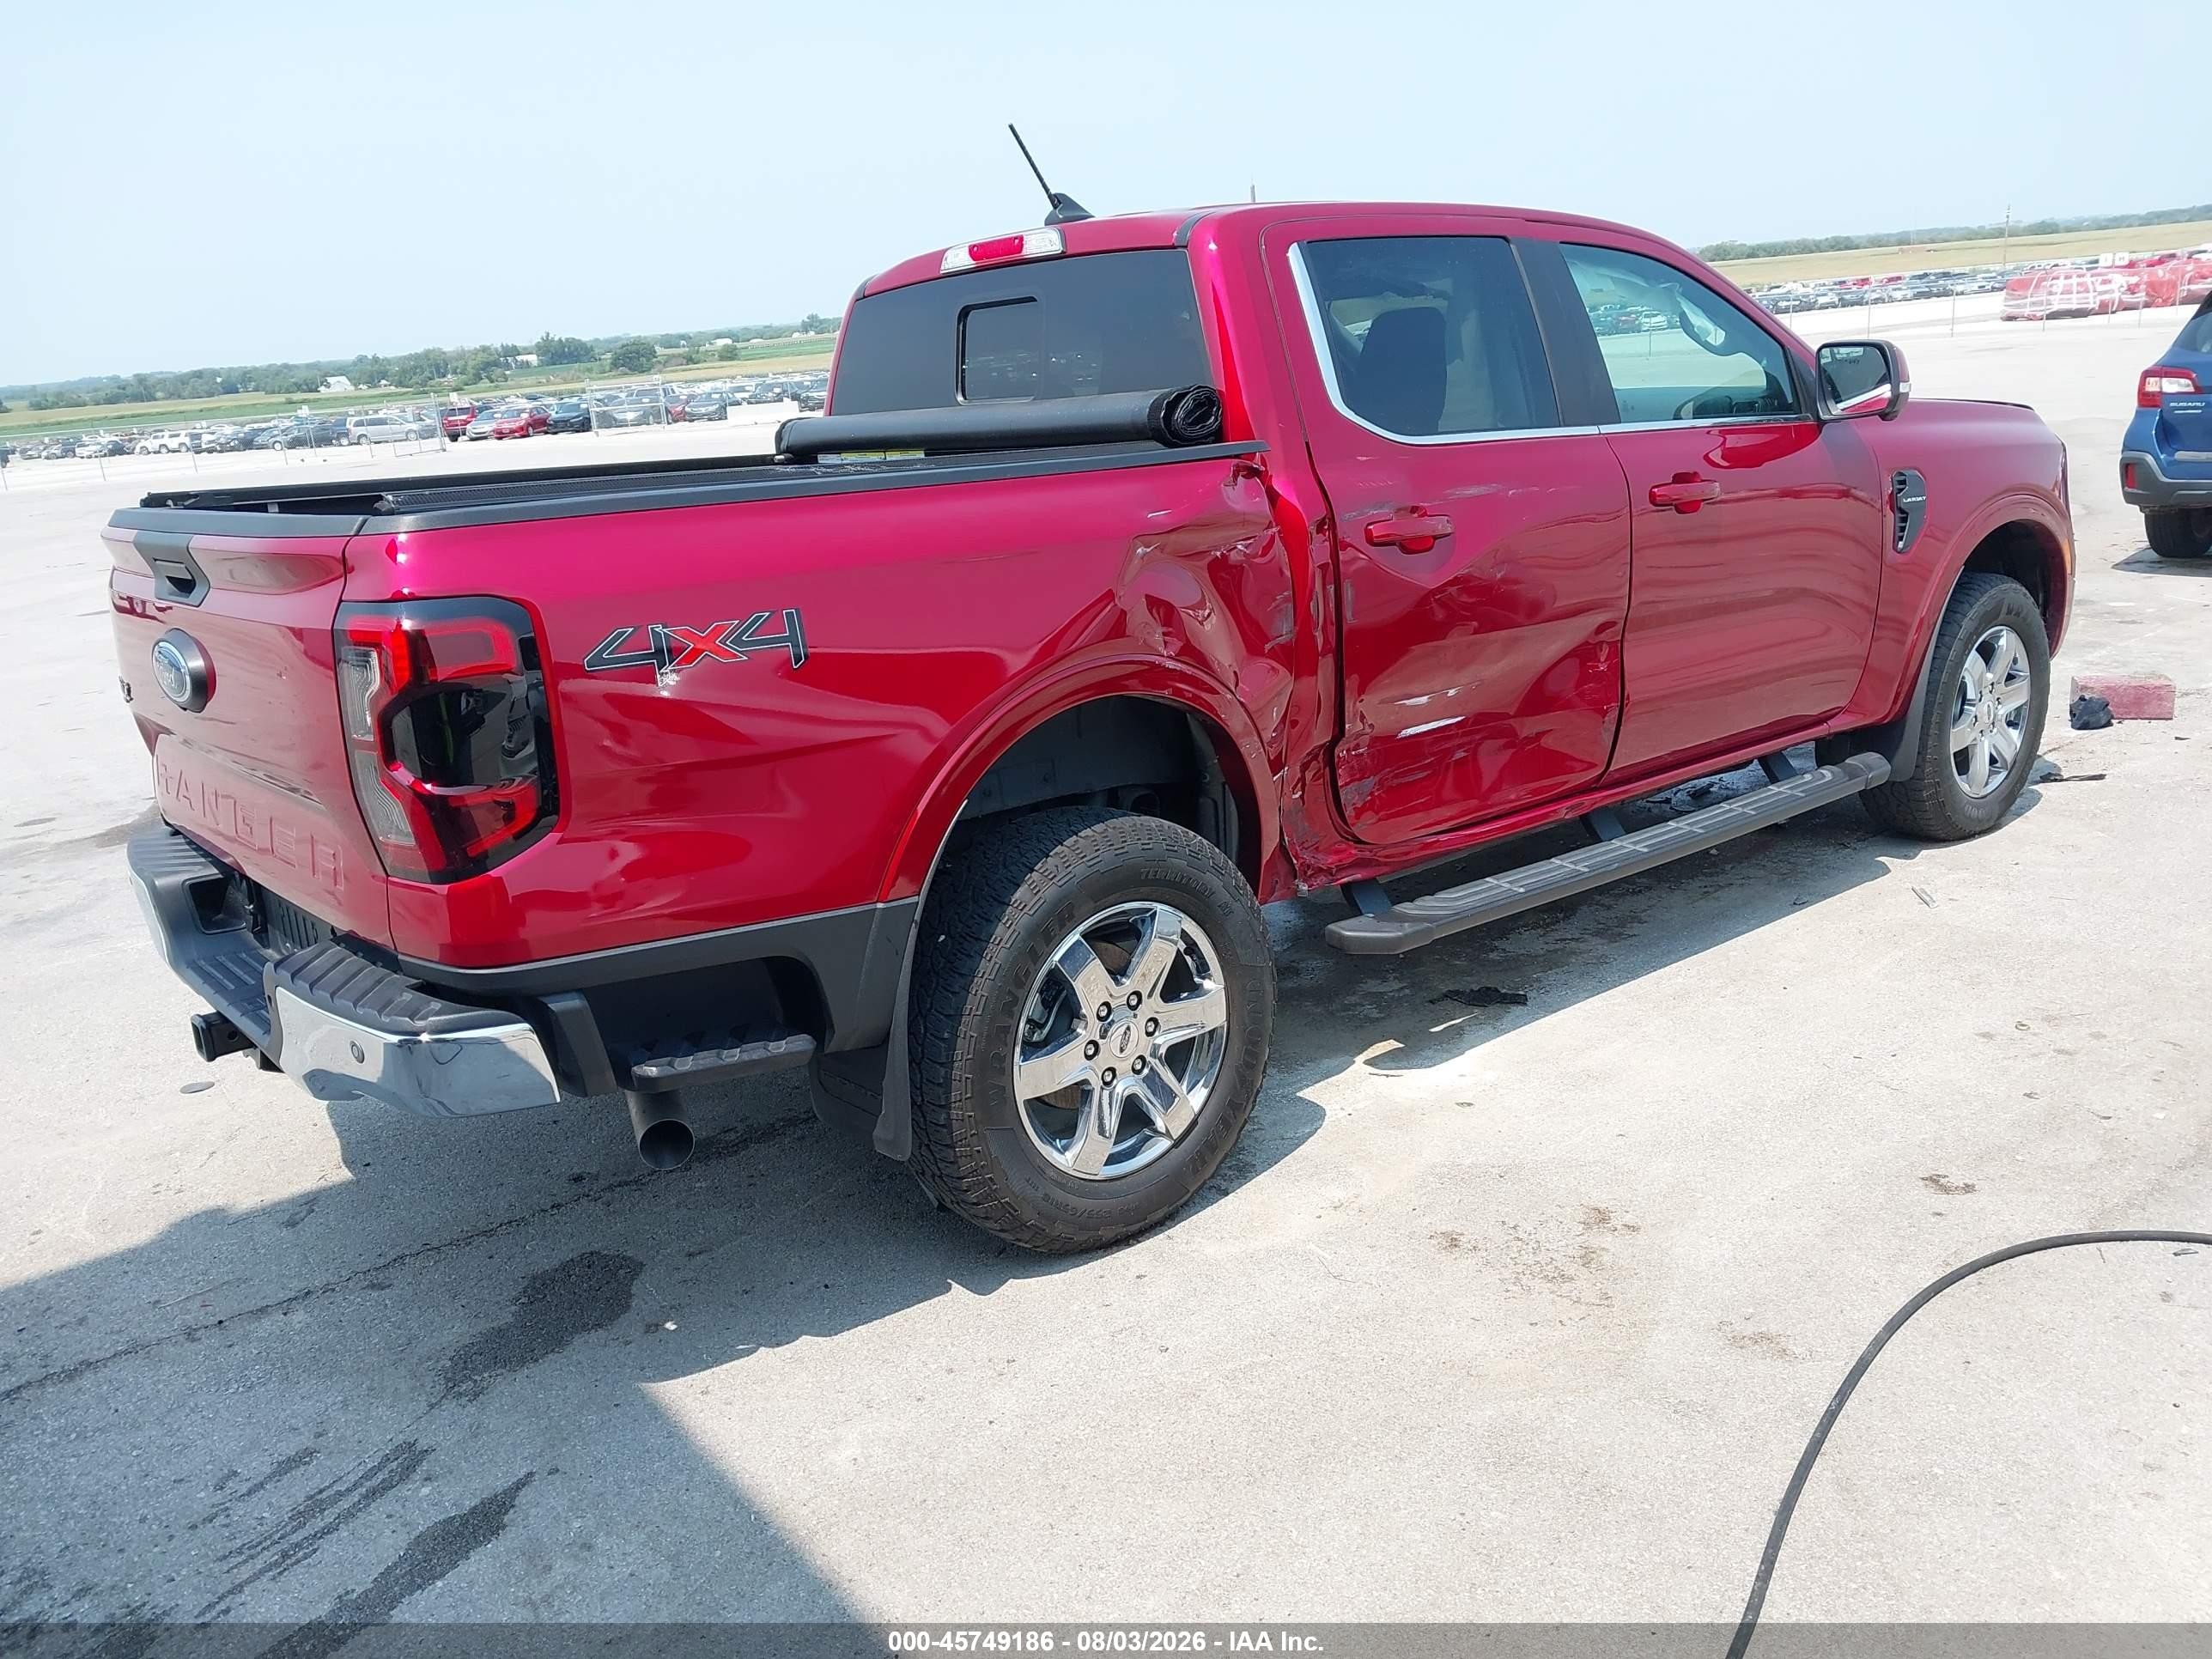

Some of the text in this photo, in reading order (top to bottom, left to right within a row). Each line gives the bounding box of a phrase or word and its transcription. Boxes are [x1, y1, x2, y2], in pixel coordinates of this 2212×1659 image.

[1902, 495, 1927, 504] LARIAT
[155, 754, 345, 890] RANGER
[988, 900, 1077, 1107] WRANGLER
[1182, 978, 1265, 1174] GOODYEAR
